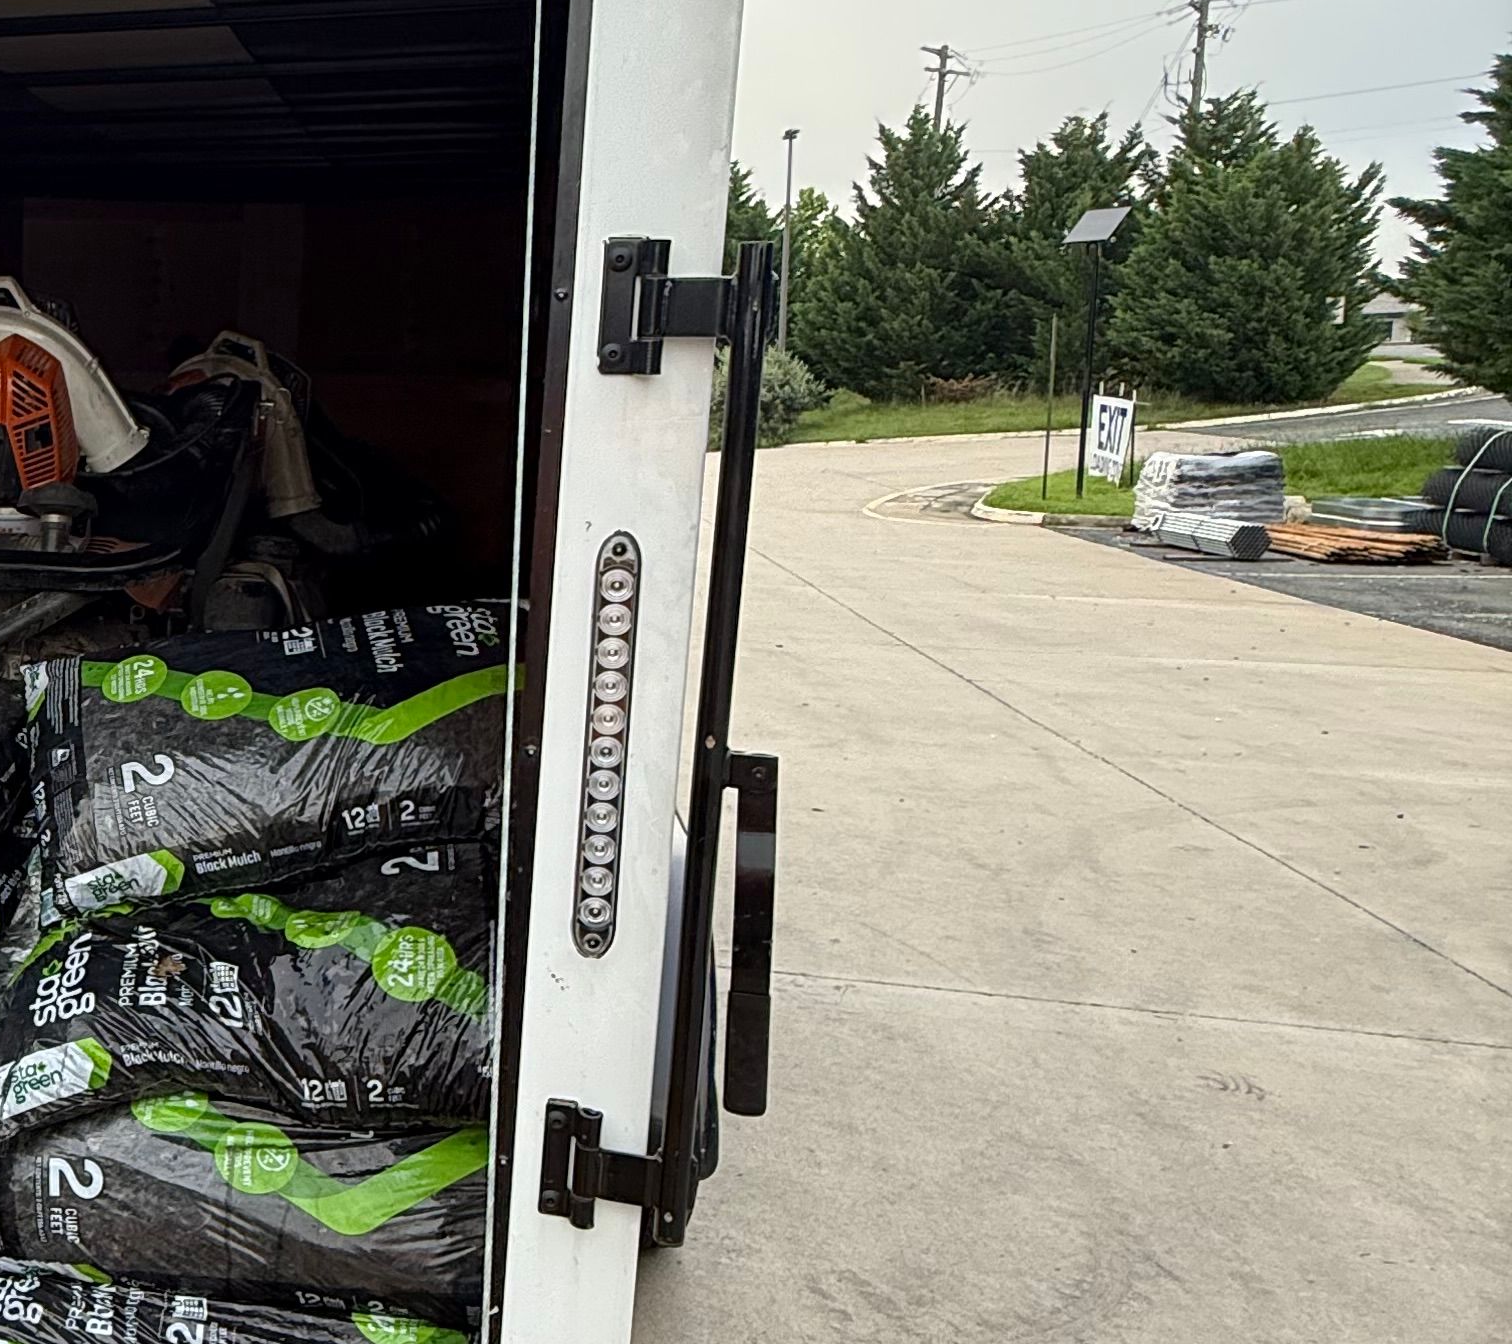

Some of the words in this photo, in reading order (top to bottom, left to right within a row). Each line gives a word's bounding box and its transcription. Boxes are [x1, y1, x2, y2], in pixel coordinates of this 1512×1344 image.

[1098, 404, 1128, 455] EXIT
[362, 611, 394, 640] Black
[370, 637, 405, 674] Mulch
[121, 755, 175, 793] 2
[127, 799, 144, 825] FEET
[140, 795, 161, 828] CUBIC
[342, 807, 365, 831] 12
[400, 800, 416, 822] 2
[192, 848, 234, 862] PREMIUM
[195, 858, 229, 876] Black
[228, 850, 262, 869] Mulch
[88, 872, 115, 889] sta
[57, 933, 96, 1020] green
[118, 942, 139, 1007] PREMIUM
[387, 935, 415, 989] 24HRS
[29, 972, 62, 1027] sta
[209, 994, 244, 1028] 12
[9, 1061, 39, 1085] sta
[12, 1069, 64, 1105] green
[301, 1077, 326, 1102] 12
[366, 1079, 384, 1103] 2
[48, 1157, 105, 1201] 2
[50, 1207, 65, 1236] FEET
[65, 1208, 81, 1245] CUBIC
